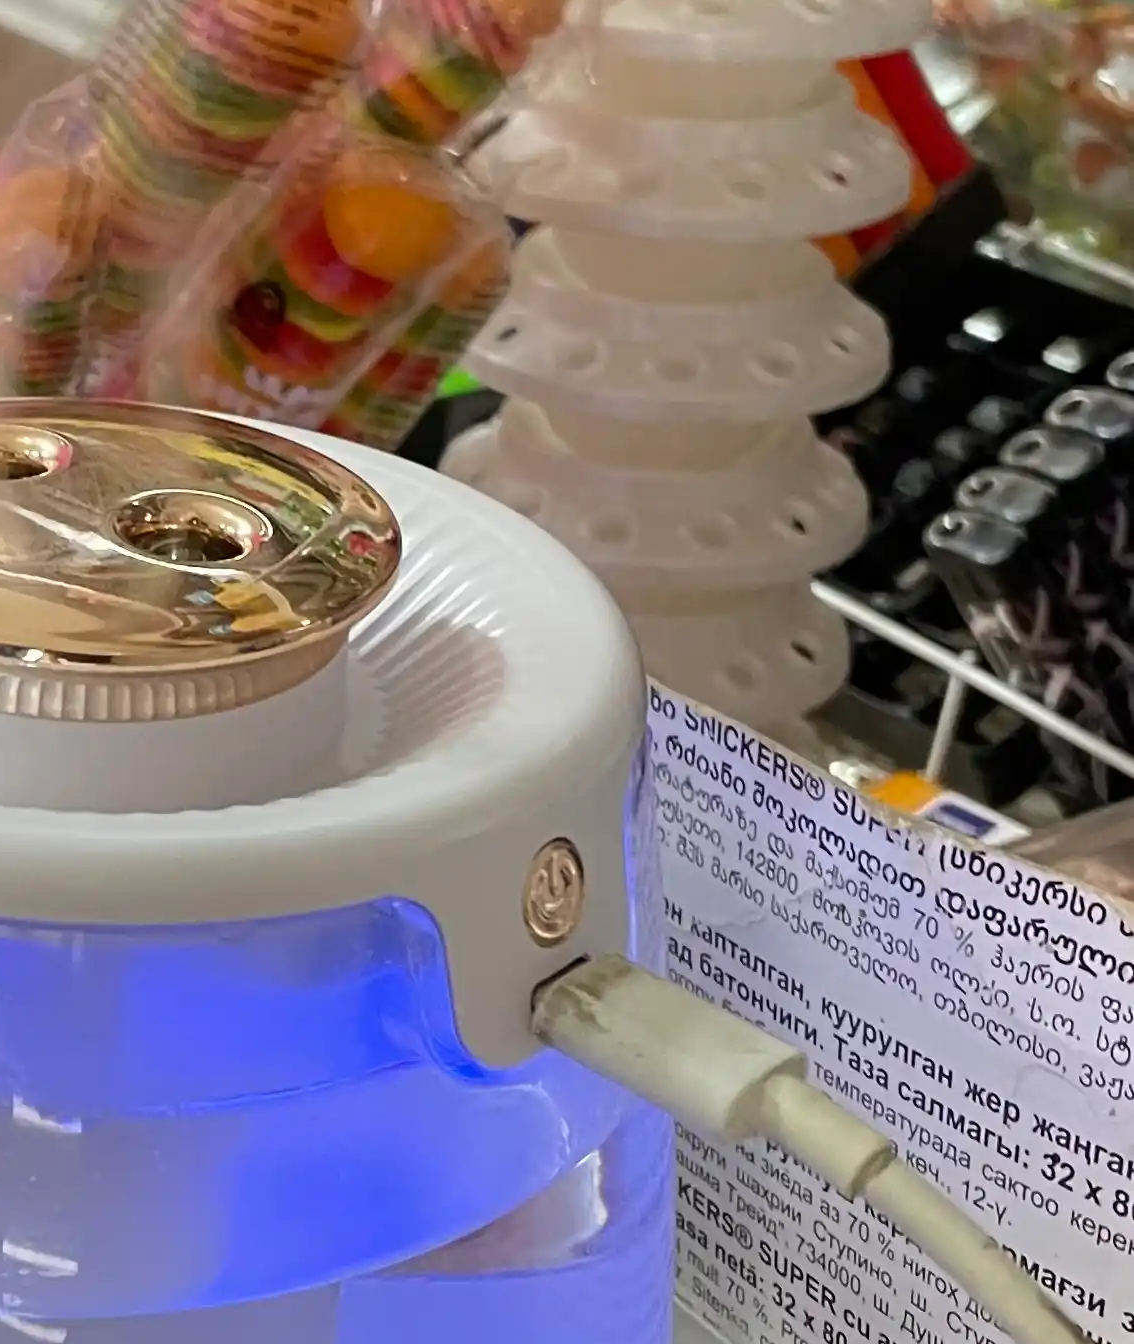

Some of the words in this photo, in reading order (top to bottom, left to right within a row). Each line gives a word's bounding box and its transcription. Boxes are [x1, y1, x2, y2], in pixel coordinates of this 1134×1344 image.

[737, 840, 798, 895] 142800
[913, 908, 938, 939] 70
[954, 926, 974, 958] %
[700, 953, 824, 1051] батончиги.
[833, 1033, 888, 1090] Таза
[898, 1081, 1030, 1170] салмагы:
[1041, 1153, 1075, 1192] 32
[822, 997, 953, 1088] куурулган
[964, 1078, 1020, 1129] жер
[982, 1163, 1059, 1216] сактоо
[820, 1199, 840, 1224] аз
[848, 1212, 869, 1244] 70
[878, 1232, 894, 1261] %
[727, 1276, 745, 1306] 70
[758, 1240, 836, 1316] SUPER
[843, 1309, 870, 1340] cu
[796, 1233, 865, 1304] 734000,
[813, 1220, 897, 1296] Ступино,
[910, 1288, 934, 1318] ш.
[772, 1282, 796, 1318] 32
